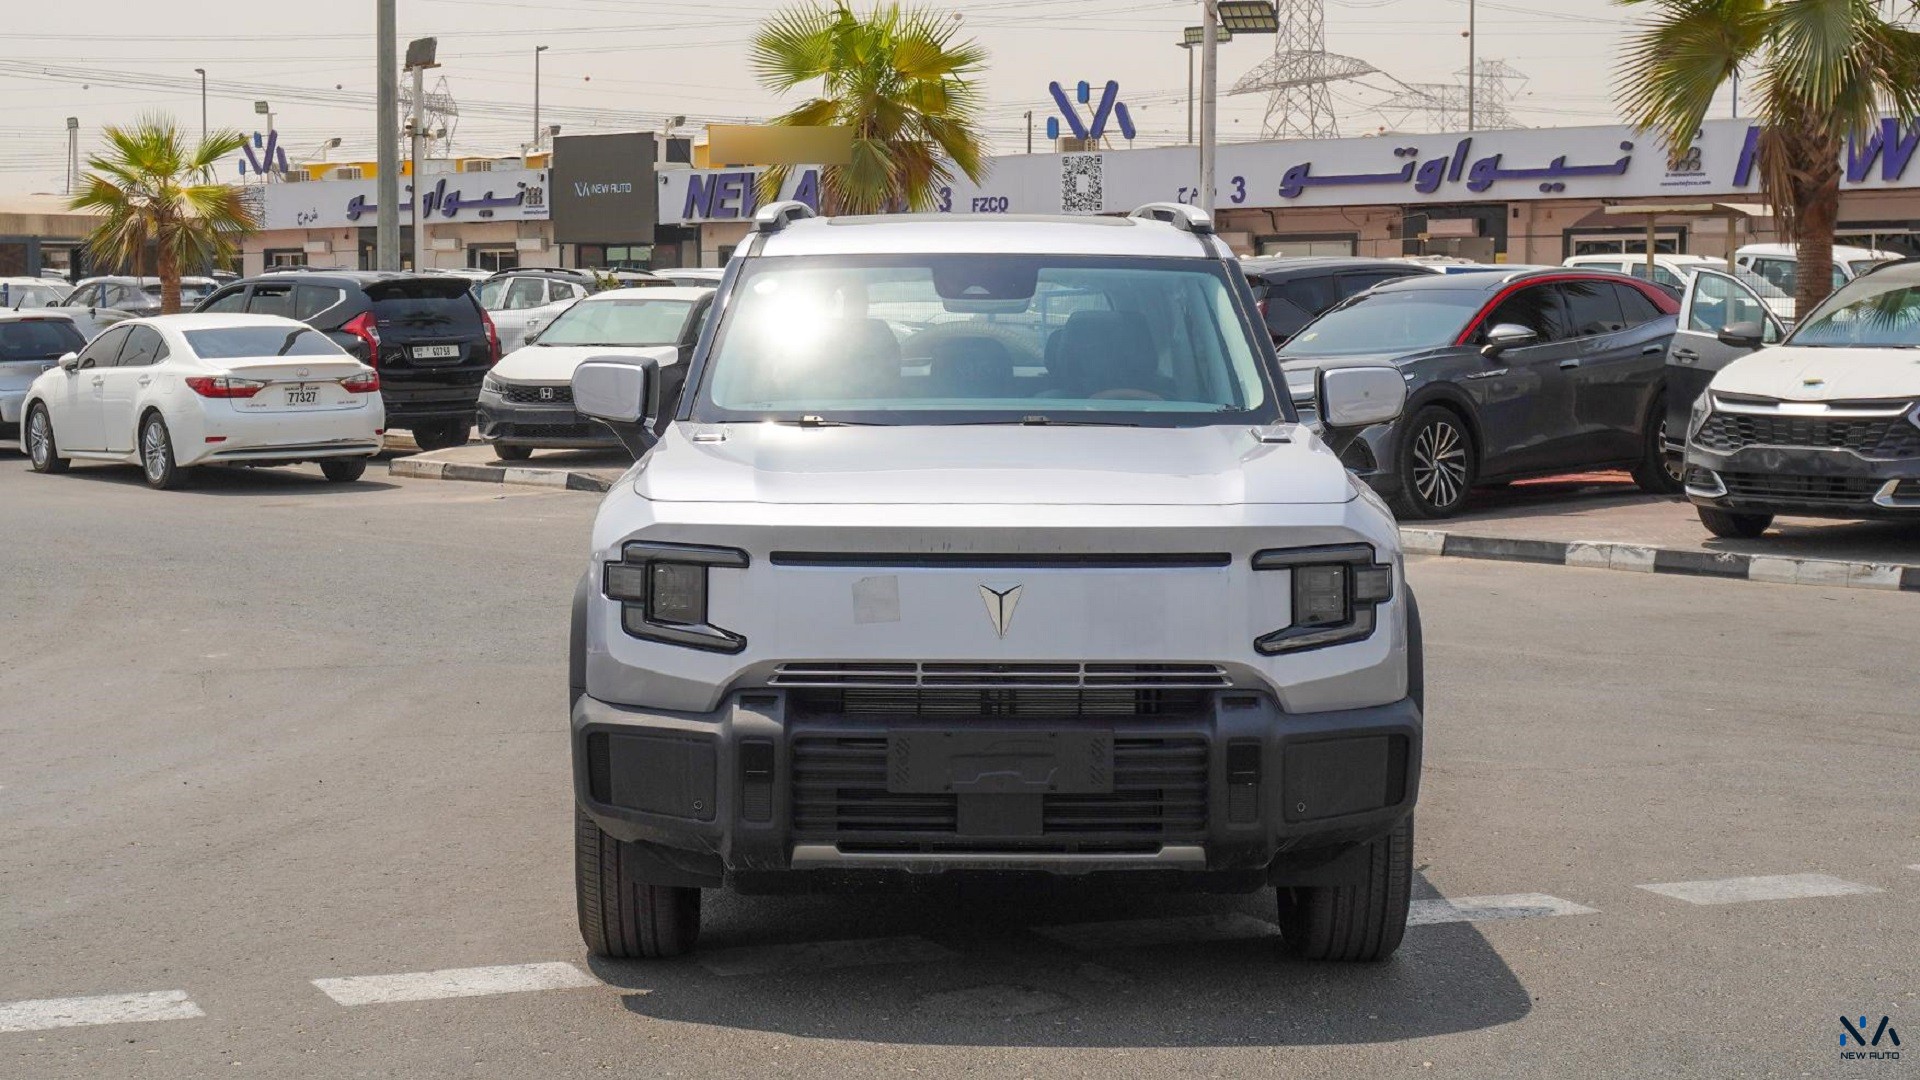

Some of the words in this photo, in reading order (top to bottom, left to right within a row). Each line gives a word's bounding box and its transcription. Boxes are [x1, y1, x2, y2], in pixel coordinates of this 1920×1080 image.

[592, 183, 609, 194] NEW
[610, 183, 632, 194] AUTO
[1230, 175, 1247, 204] 3
[288, 391, 316, 403] 77327
